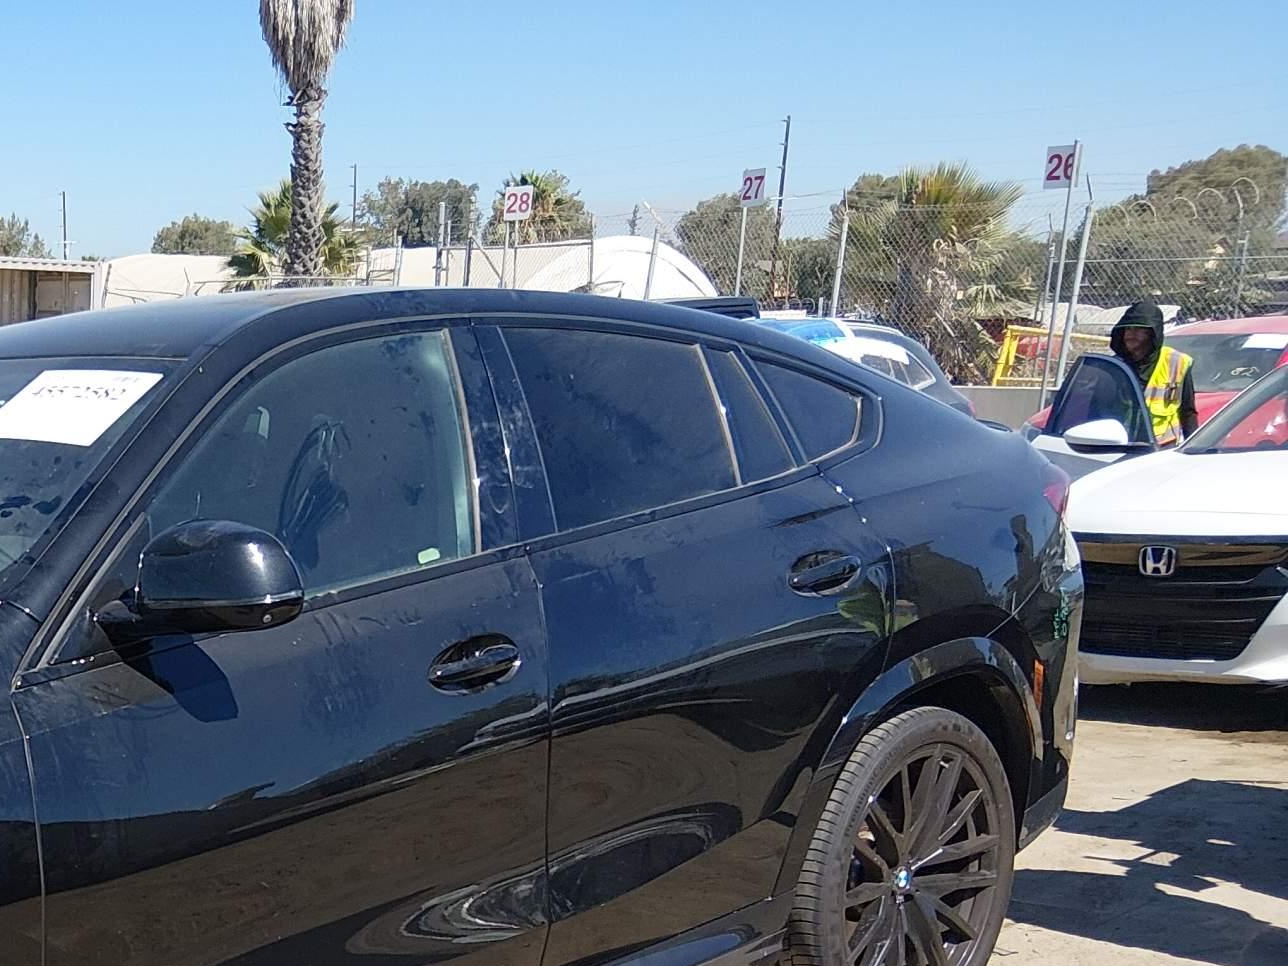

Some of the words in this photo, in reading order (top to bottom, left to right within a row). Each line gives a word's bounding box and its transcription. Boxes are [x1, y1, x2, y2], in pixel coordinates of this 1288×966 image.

[1046, 152, 1074, 181] 26
[742, 175, 765, 201] 27
[505, 191, 531, 214] 28
